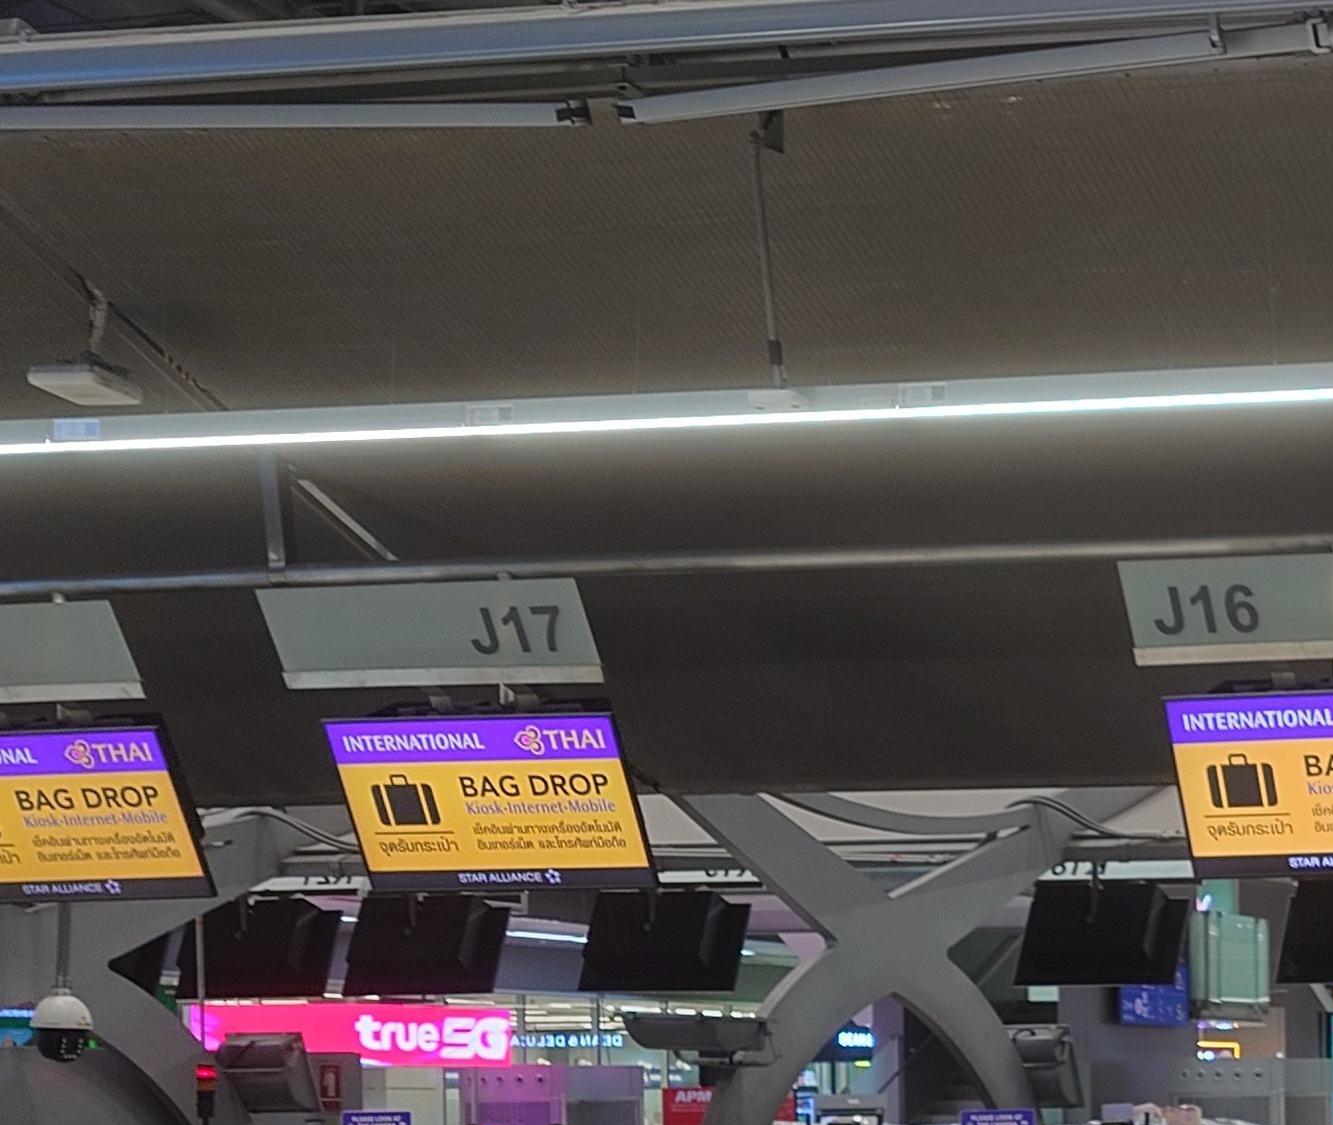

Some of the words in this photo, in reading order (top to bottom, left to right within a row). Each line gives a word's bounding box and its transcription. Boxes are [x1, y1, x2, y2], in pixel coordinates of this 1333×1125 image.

[1154, 584, 1260, 635] J16
[470, 604, 560, 656] J17
[342, 732, 485, 753] INTERNATIONAL
[543, 728, 606, 750] THAI
[92, 742, 153, 763] THAI
[458, 776, 520, 798] BAG
[528, 773, 609, 797] DROP
[15, 788, 75, 811] BAG
[81, 786, 159, 808] DROP
[1206, 818, 1294, 842] จุดรับกระเป๋า
[379, 834, 460, 857] จุดรับกระเป๋า
[1288, 856, 1321, 869] STAR
[22, 884, 51, 895] STAR
[52, 881, 103, 894] ALLIANCE
[458, 872, 488, 884] STAR
[489, 870, 543, 883] ALLIANCE
